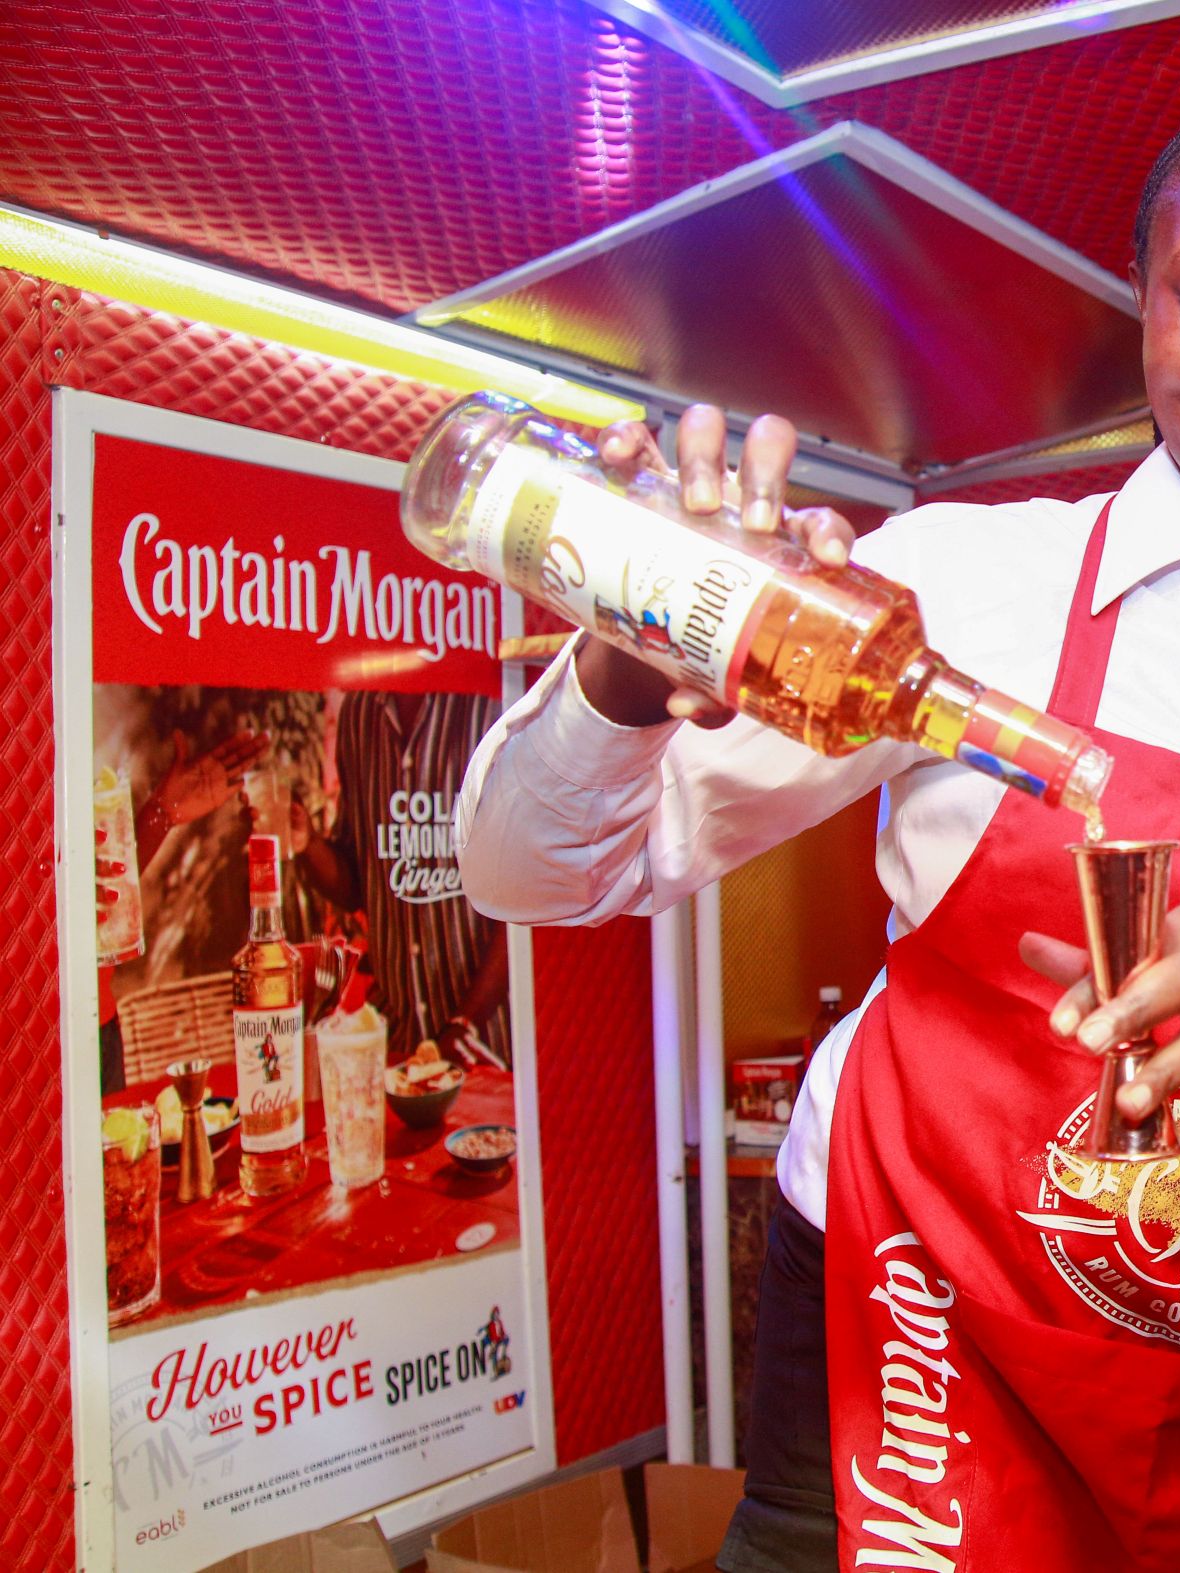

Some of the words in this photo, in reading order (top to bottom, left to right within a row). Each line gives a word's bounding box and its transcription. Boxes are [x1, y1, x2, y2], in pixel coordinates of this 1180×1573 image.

[118, 512, 318, 640] Captain
[317, 544, 498, 662] Morgan
[681, 559, 752, 663] Captain
[251, 1085, 292, 1114] Gold
[1084, 1256, 1140, 1298] RUM
[146, 1317, 358, 1422] However
[208, 1404, 243, 1426] YOU
[253, 1360, 375, 1436] SPICE
[385, 1356, 452, 1406] SPICE
[456, 1340, 488, 1382] ON
[202, 1486, 255, 1510] EXCESSIVE
[256, 1469, 301, 1491] ALCOHOL
[303, 1445, 367, 1474] CONSUMPTION
[230, 1502, 251, 1515] NOT
[254, 1493, 272, 1506] FOR
[275, 1483, 297, 1498] SALE
[300, 1479, 311, 1490] TO
[313, 1464, 352, 1484] PERSONS
[354, 1454, 383, 1470] UNDER
[135, 1514, 178, 1546] eabl
